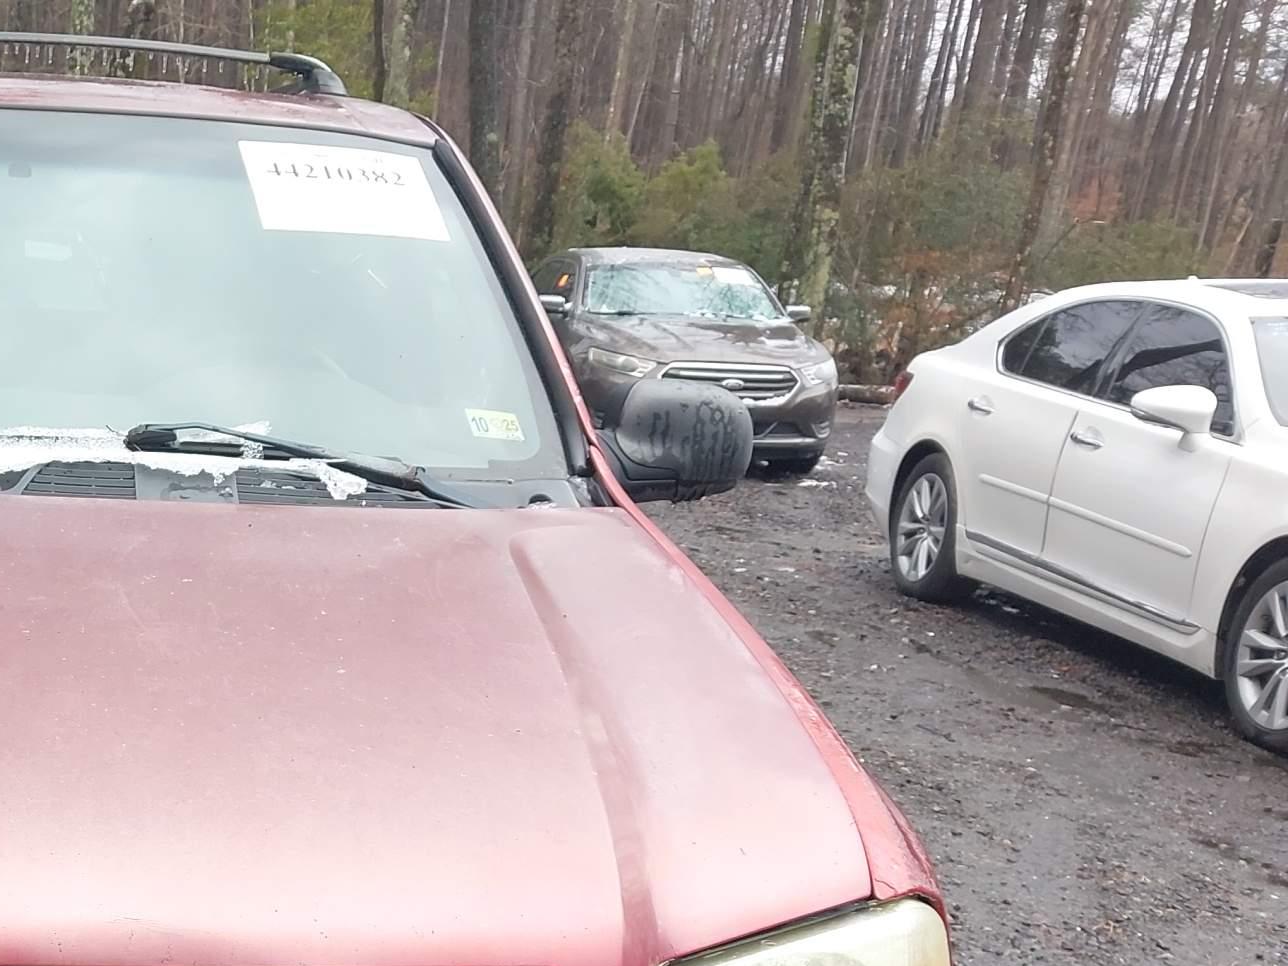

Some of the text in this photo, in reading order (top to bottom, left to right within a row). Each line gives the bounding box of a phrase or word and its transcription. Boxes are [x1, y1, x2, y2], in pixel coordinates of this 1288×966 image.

[266, 161, 406, 187] 44210382
[471, 416, 519, 433] 10 25
